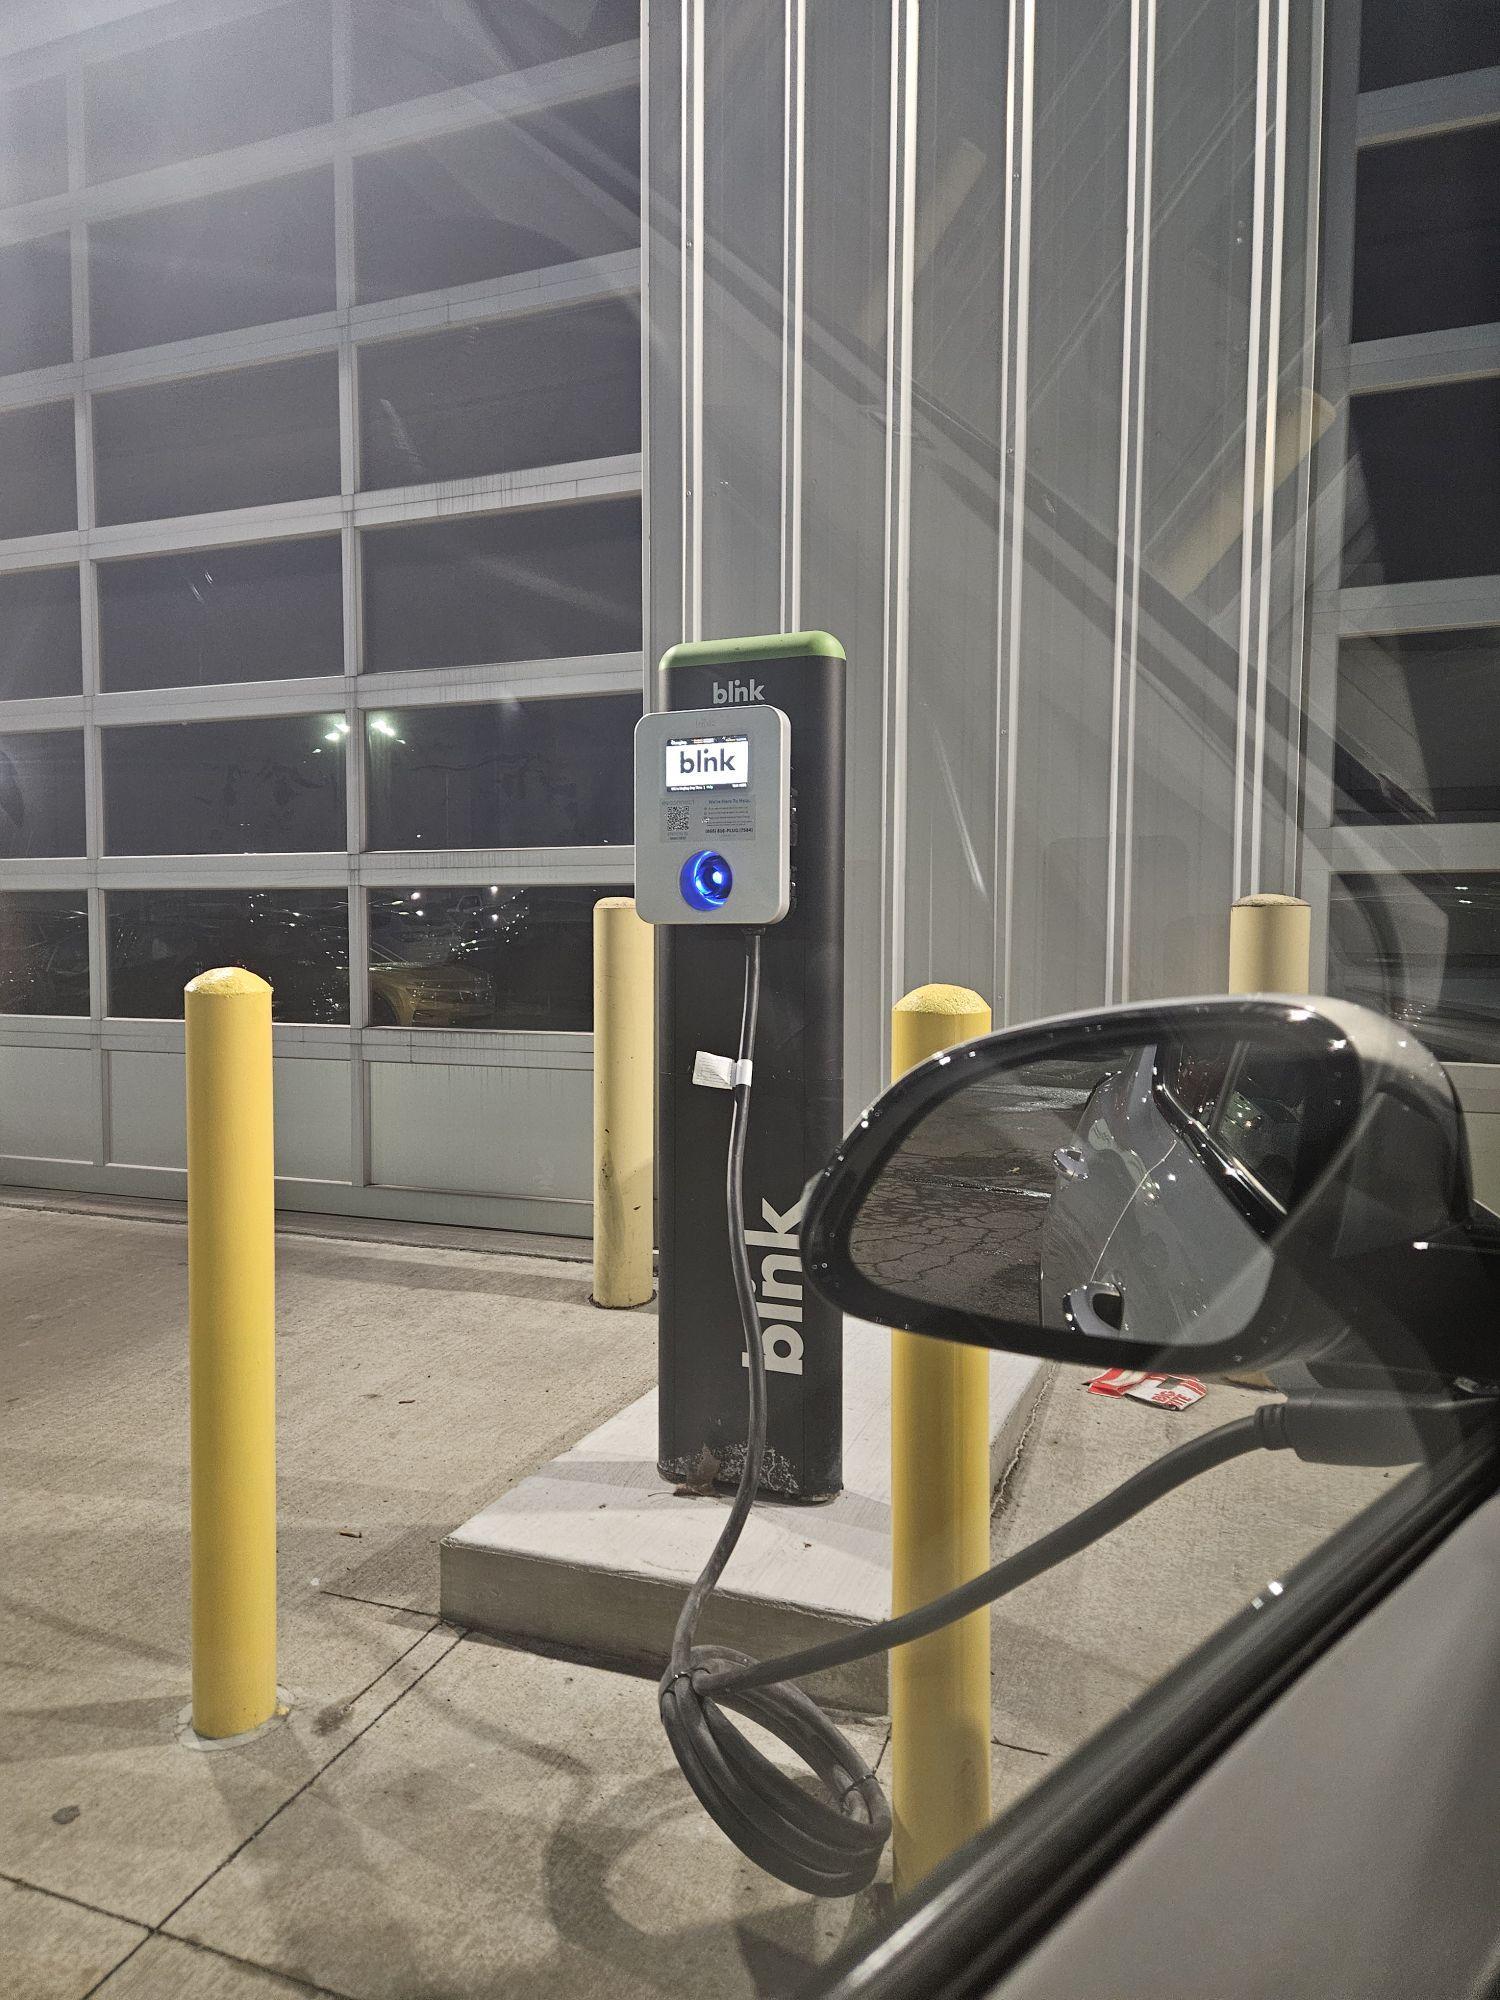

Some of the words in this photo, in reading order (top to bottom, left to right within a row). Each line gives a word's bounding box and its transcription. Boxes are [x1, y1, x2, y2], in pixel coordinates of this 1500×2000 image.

[713, 679, 765, 704] blink
[680, 748, 735, 773] blink
[741, 1197, 804, 1375] blink
